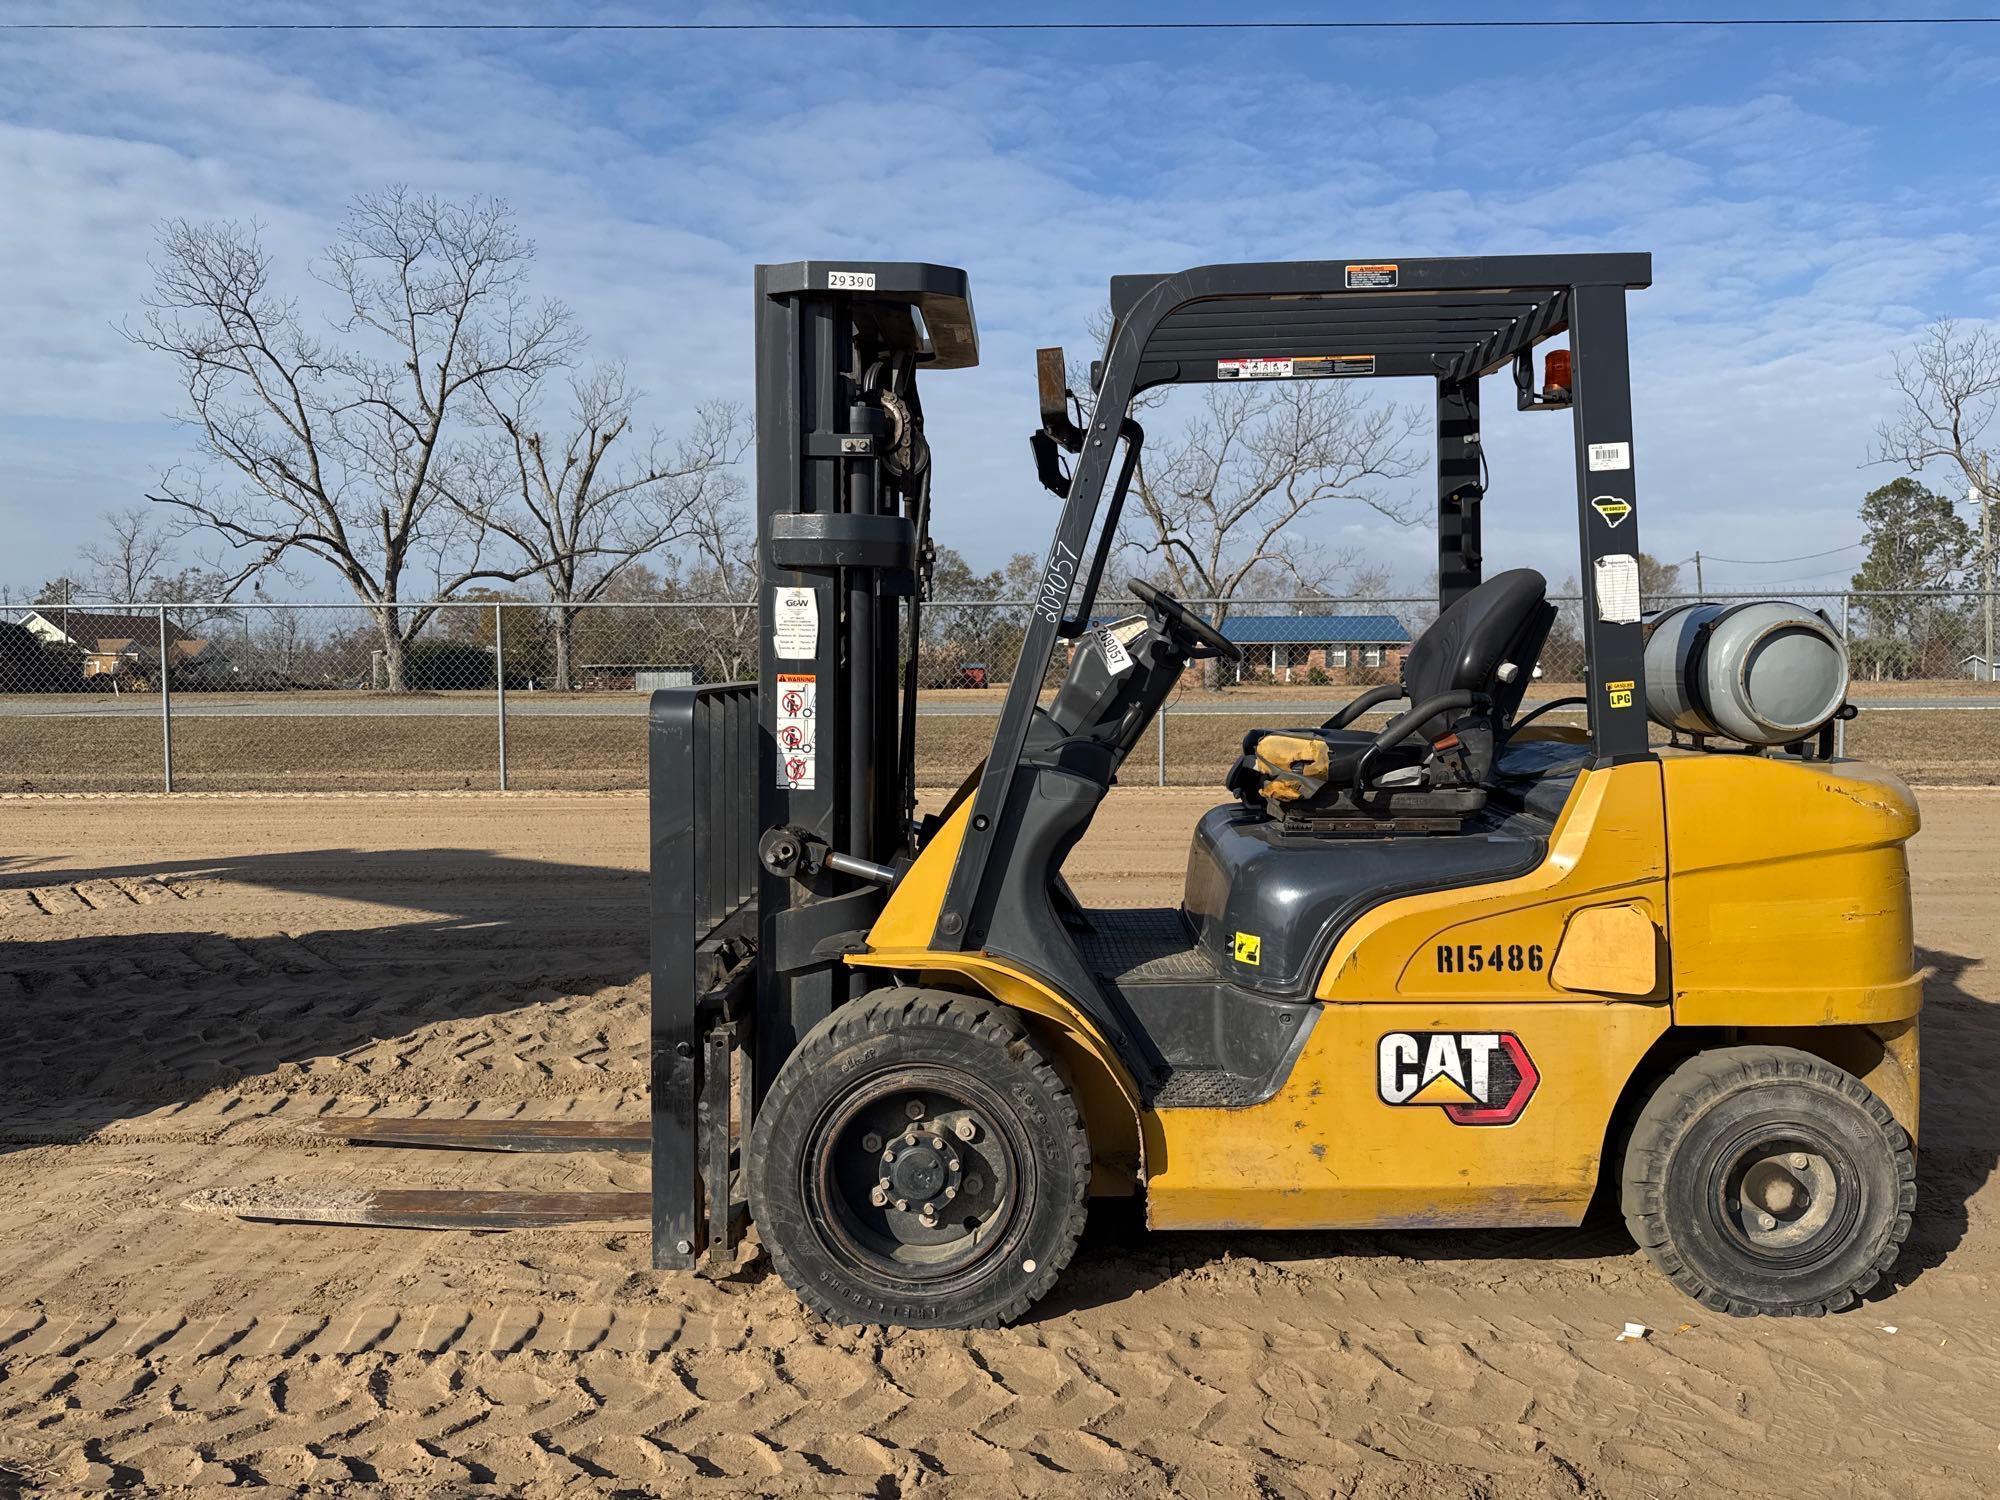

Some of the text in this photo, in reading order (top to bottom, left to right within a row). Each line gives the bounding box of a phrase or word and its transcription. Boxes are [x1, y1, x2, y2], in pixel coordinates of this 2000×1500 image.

[830, 274, 874, 288] 29390
[1035, 541, 1078, 623] 209057
[786, 599, 809, 607] G&W
[1097, 627, 1125, 664] 209057
[1611, 694, 1630, 705] LPG
[1379, 1032, 1500, 1104] CAT
